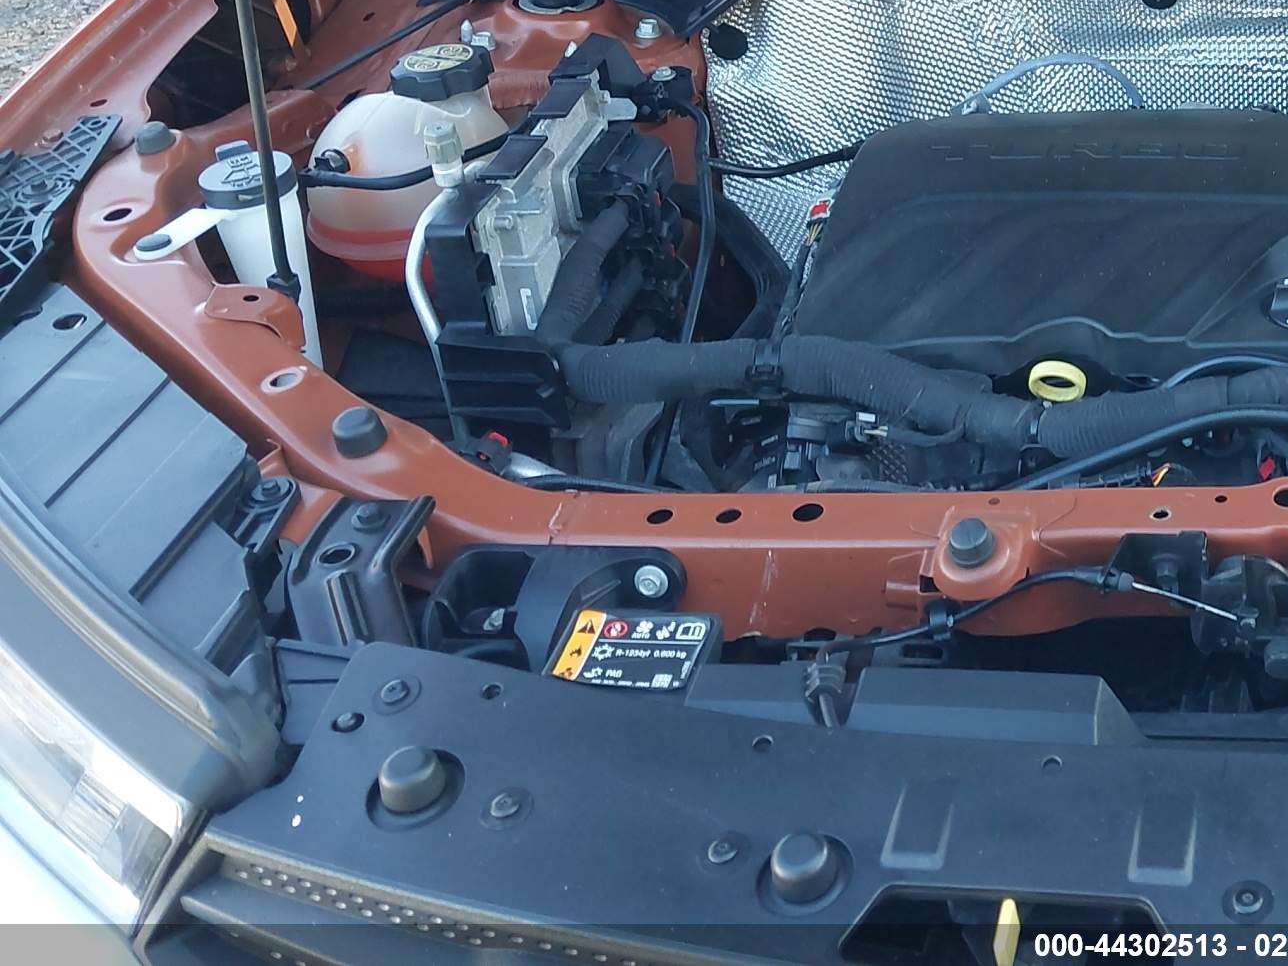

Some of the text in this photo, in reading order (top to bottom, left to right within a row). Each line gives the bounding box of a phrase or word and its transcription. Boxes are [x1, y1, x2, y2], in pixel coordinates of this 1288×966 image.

[929, 139, 1246, 161] TURBO
[631, 632, 651, 640] AUTO
[615, 649, 652, 660] R-1234yf
[675, 650, 687, 660] kg
